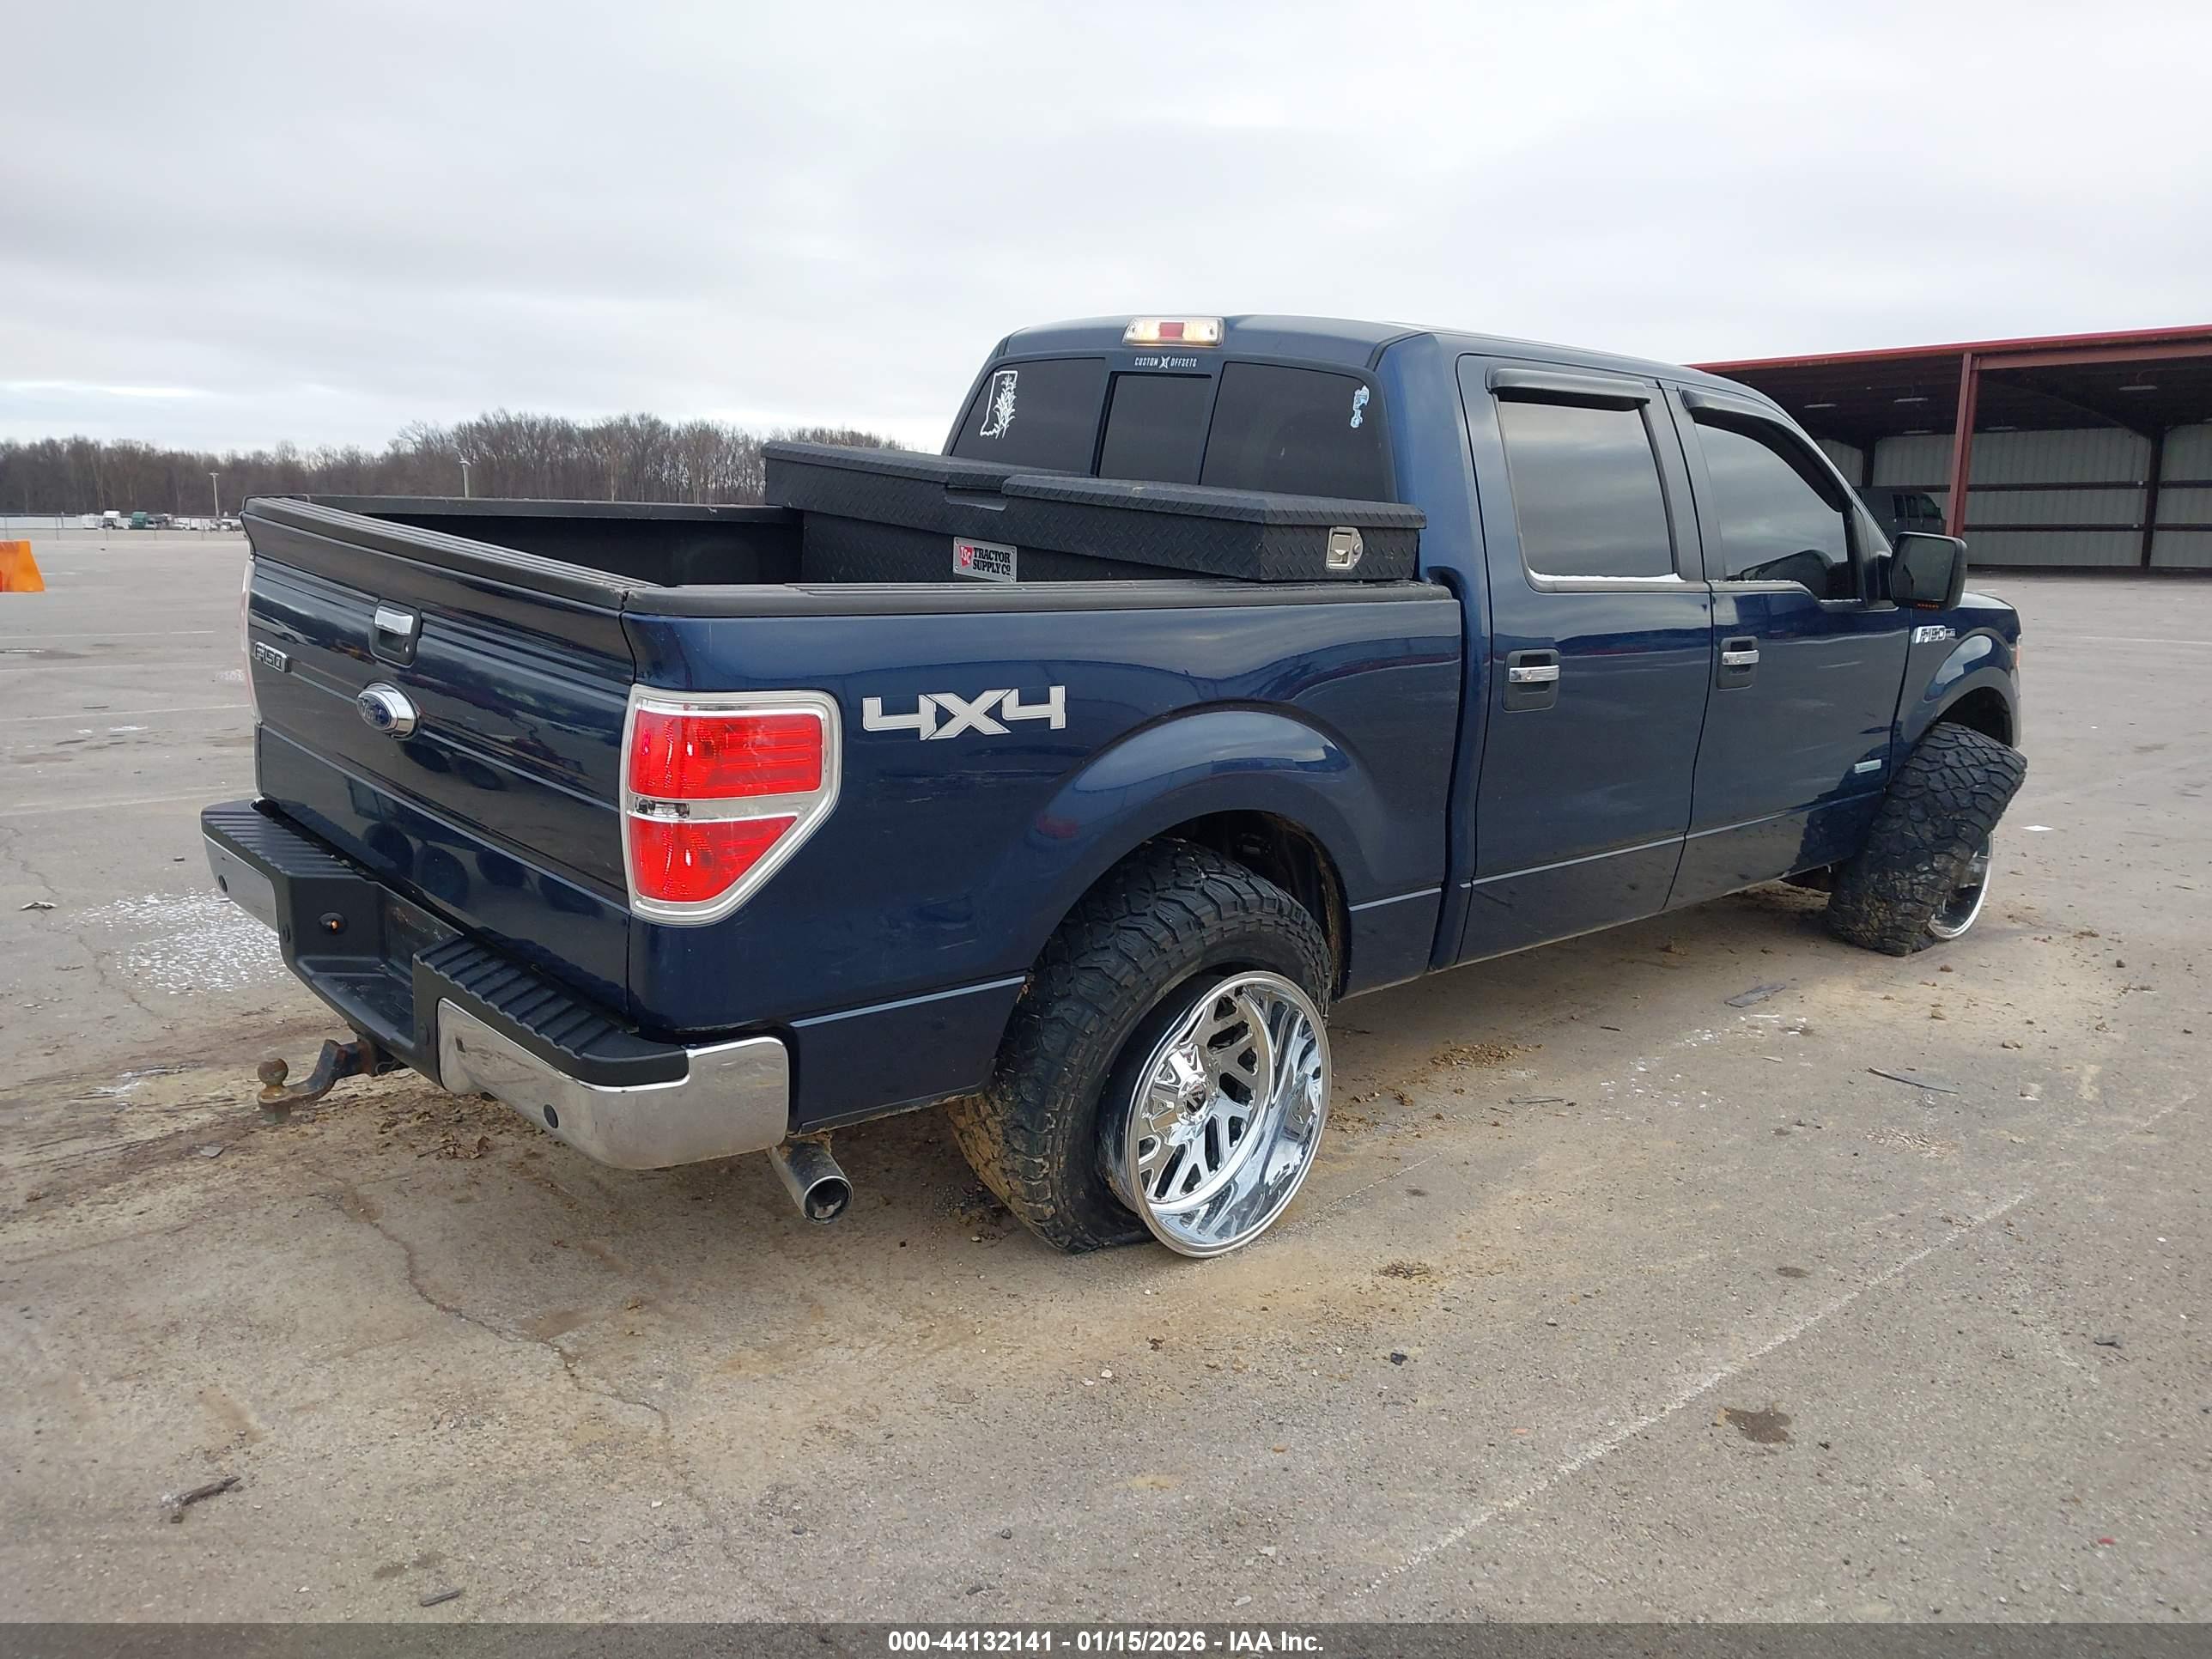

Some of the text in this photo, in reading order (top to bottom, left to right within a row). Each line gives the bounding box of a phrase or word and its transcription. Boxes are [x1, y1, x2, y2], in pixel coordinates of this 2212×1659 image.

[1134, 356, 1158, 367] CUSTOM
[1170, 357, 1198, 368] OFFSETS
[960, 546, 971, 564] TSC
[973, 547, 1011, 563] TRACTOR
[972, 559, 1001, 574] SUPPLY
